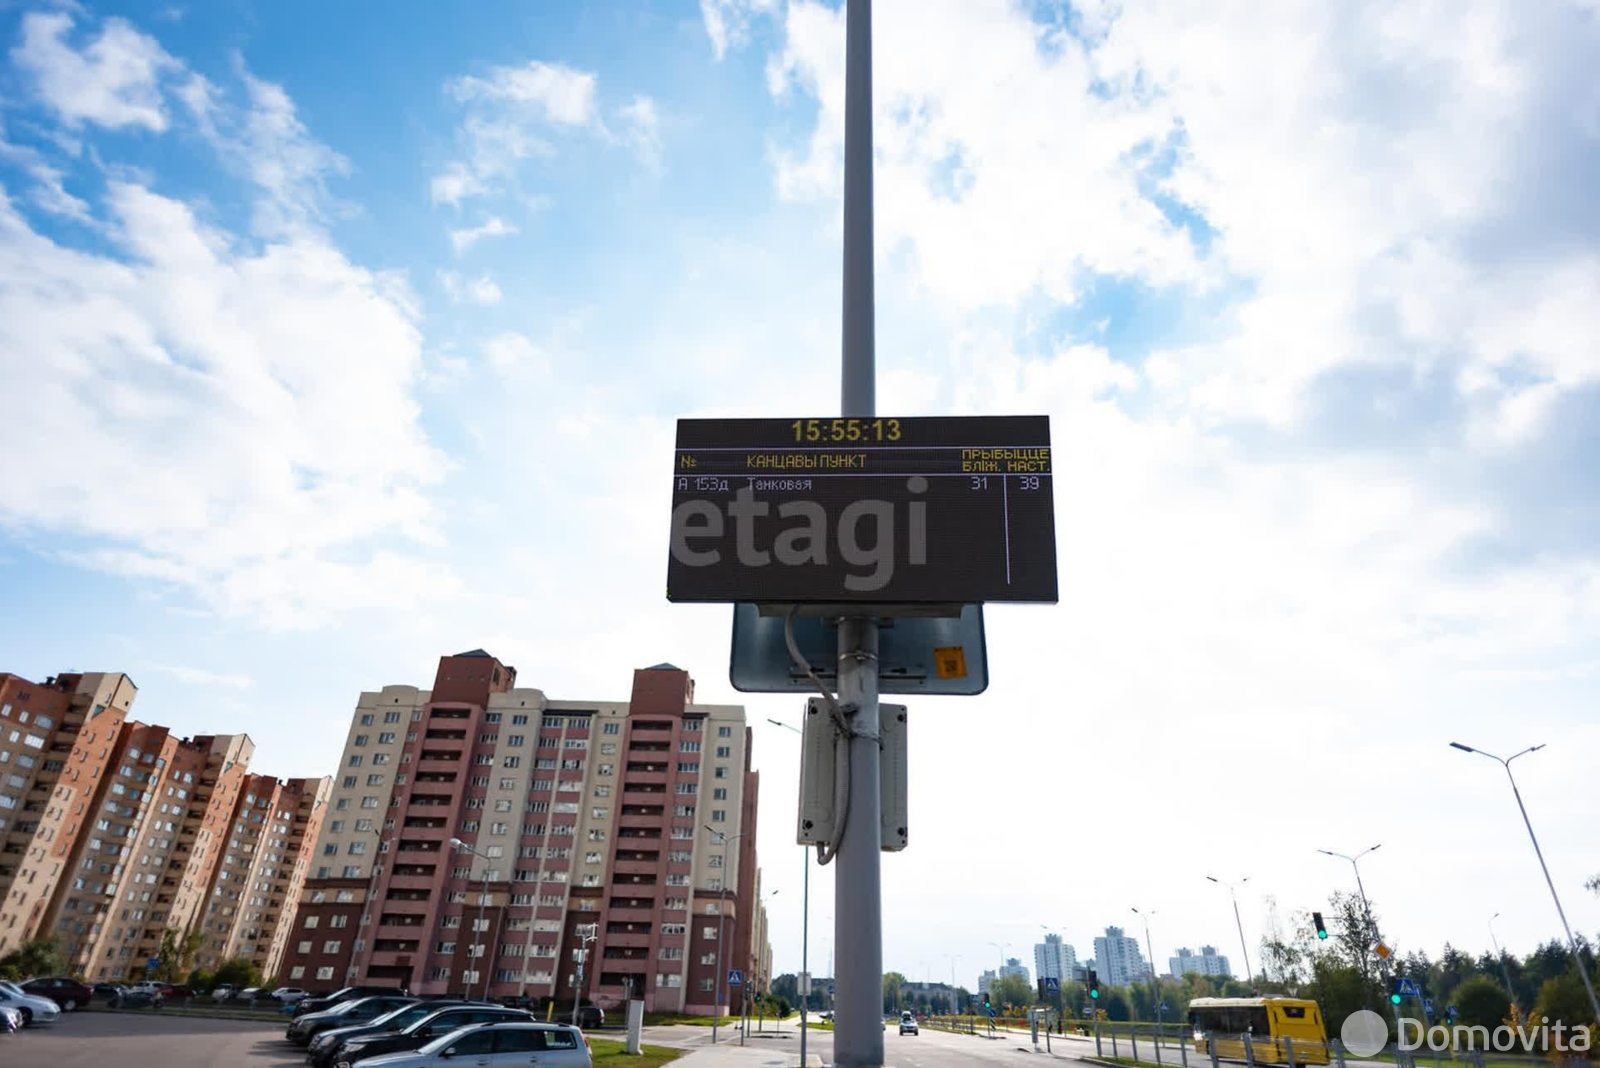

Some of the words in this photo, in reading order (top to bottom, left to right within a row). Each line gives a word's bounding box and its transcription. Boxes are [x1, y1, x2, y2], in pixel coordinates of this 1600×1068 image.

[792, 419, 902, 442] 15:55:13
[820, 454, 867, 468] ПУНКТ
[961, 449, 1050, 460] ПРЫБЫЦЦЕ
[747, 477, 812, 491] Танковая
[970, 476, 988, 490] 31
[1019, 476, 1040, 490] 39
